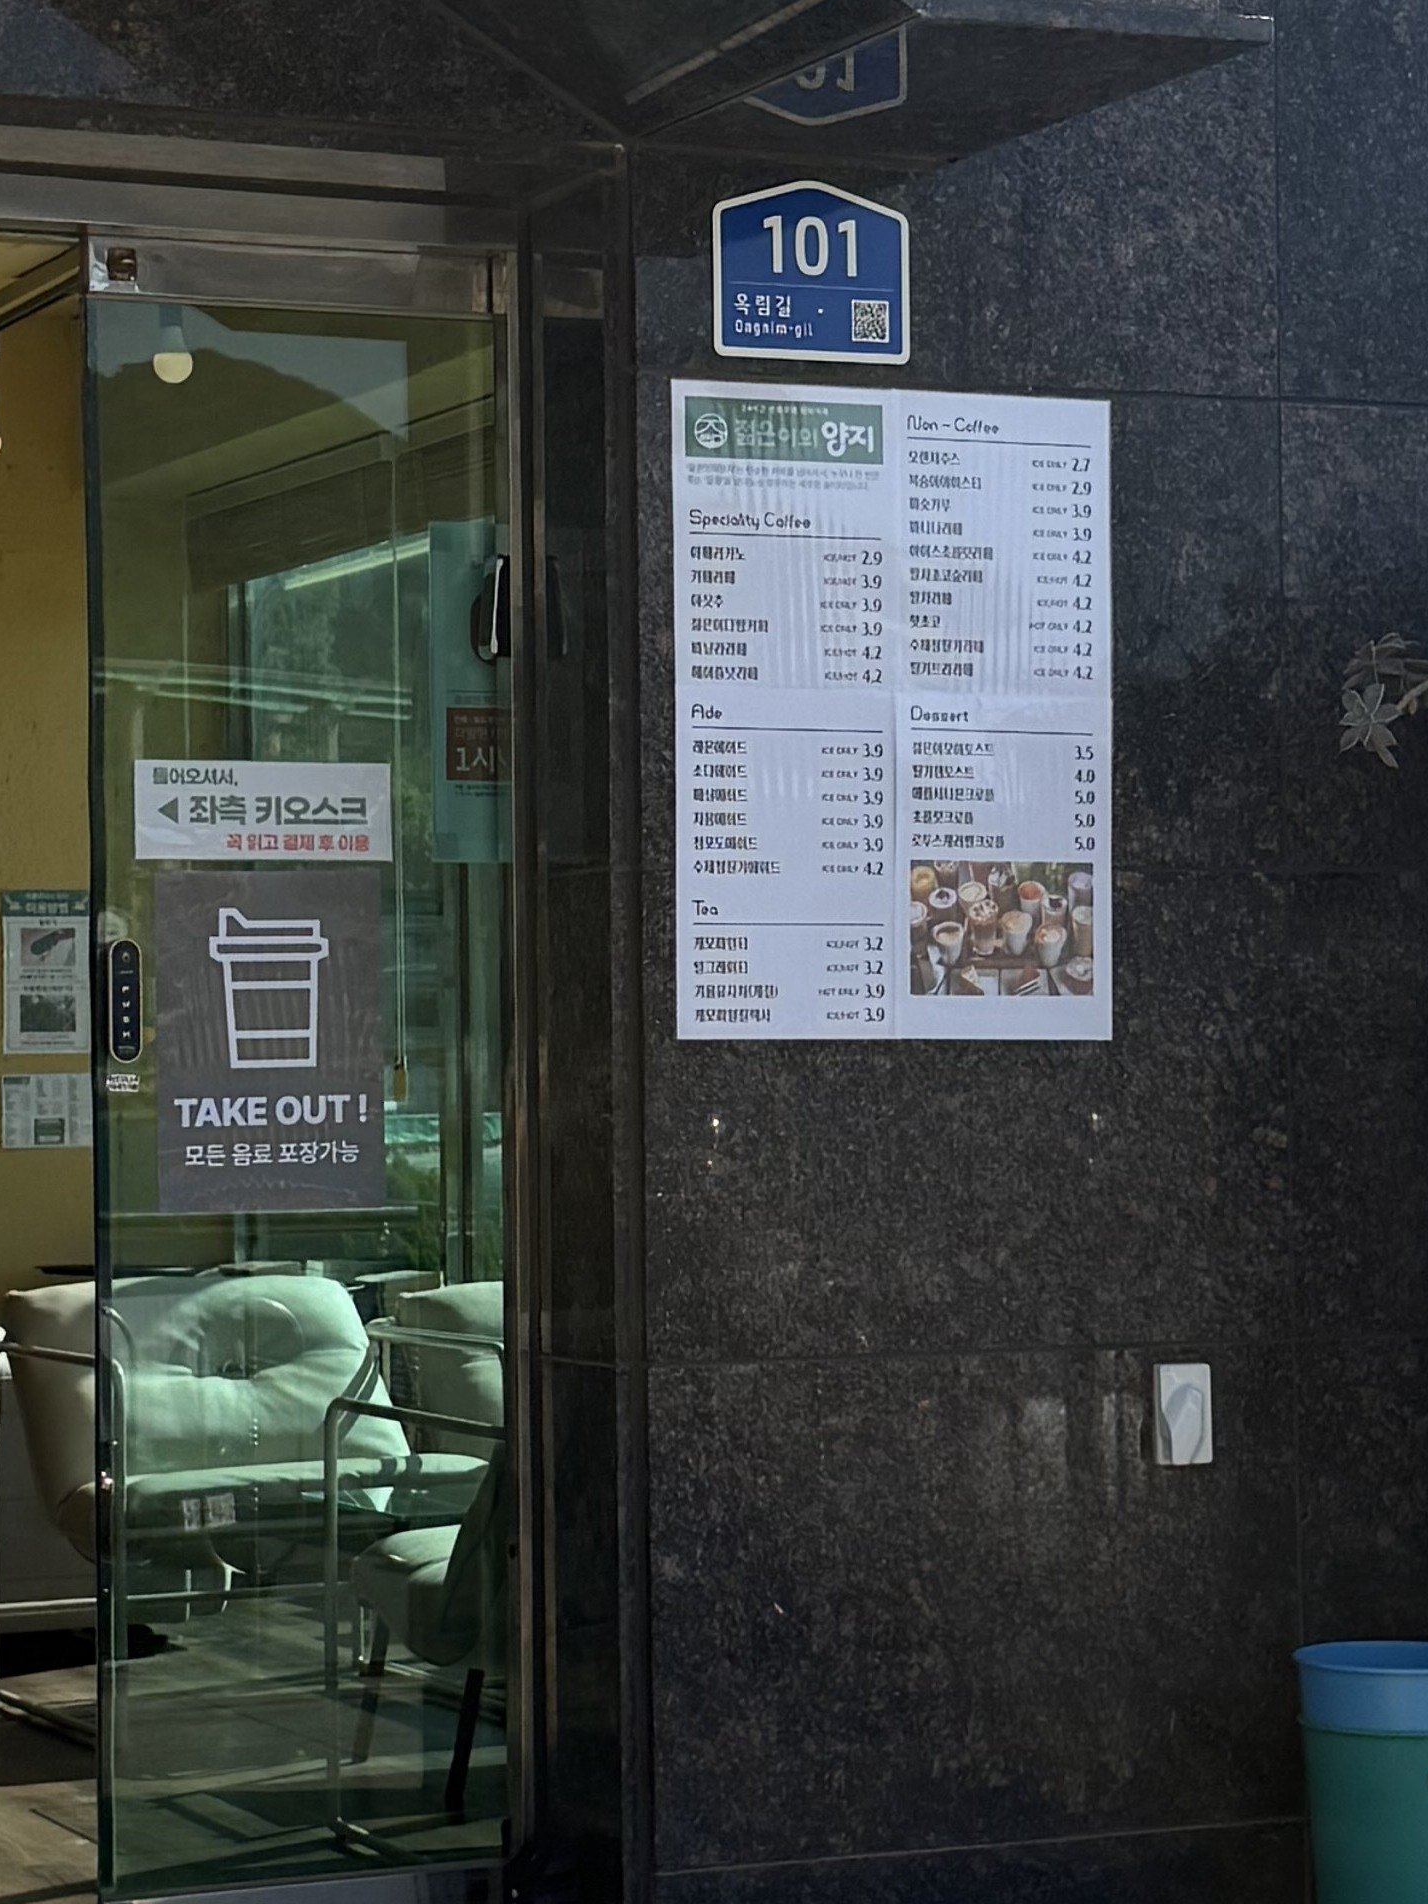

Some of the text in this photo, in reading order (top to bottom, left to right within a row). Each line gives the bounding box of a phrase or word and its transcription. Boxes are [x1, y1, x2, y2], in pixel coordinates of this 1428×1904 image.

[763, 215, 858, 277] 101
[734, 293, 791, 318] 옥림길
[906, 414, 1000, 435] Non Coffee
[821, 420, 873, 458] 양지
[1071, 458, 1092, 472] 2.7
[1071, 481, 1092, 496] 2.9
[1071, 504, 1092, 519] 3.9
[763, 511, 811, 530] Coffee
[1071, 527, 1092, 542] 3.9
[861, 550, 883, 566] 2.9
[1071, 550, 1092, 565] 4.2
[861, 574, 883, 589] 3.9
[1071, 573, 1092, 588] 4.2
[861, 598, 883, 613] 3.9
[1071, 596, 1092, 611] 4.2
[861, 621, 883, 637] 3.9
[1072, 619, 1093, 634] 4.2
[861, 645, 883, 660] 4.2
[1072, 642, 1093, 657] 4.2
[861, 669, 883, 684] 4.2
[1072, 666, 1094, 680] 4.2
[691, 703, 723, 720] Ade
[910, 705, 970, 723] Dessert
[862, 743, 884, 758] 3.9
[1074, 745, 1096, 761] 3.5
[862, 767, 884, 782] 3.9
[1074, 769, 1096, 784] 4.0
[862, 790, 884, 805] 3.9
[1074, 790, 1096, 805] 5.0
[189, 794, 368, 826] 좌측 키오스크
[862, 814, 884, 829] 3.9
[1074, 814, 1096, 828] 5.0
[862, 837, 884, 852] 3.9
[1074, 837, 1096, 851] 5.0
[862, 861, 884, 876] 4.2
[691, 899, 719, 916] Tea
[863, 936, 884, 951] 3.2
[863, 960, 884, 975] 3.2
[863, 983, 885, 999] 3.9
[863, 1007, 885, 1022] 3.9
[173, 1097, 268, 1128] TAKE
[275, 1095, 351, 1126] OUT
[184, 1140, 360, 1167] 모든 음료 포장가능
